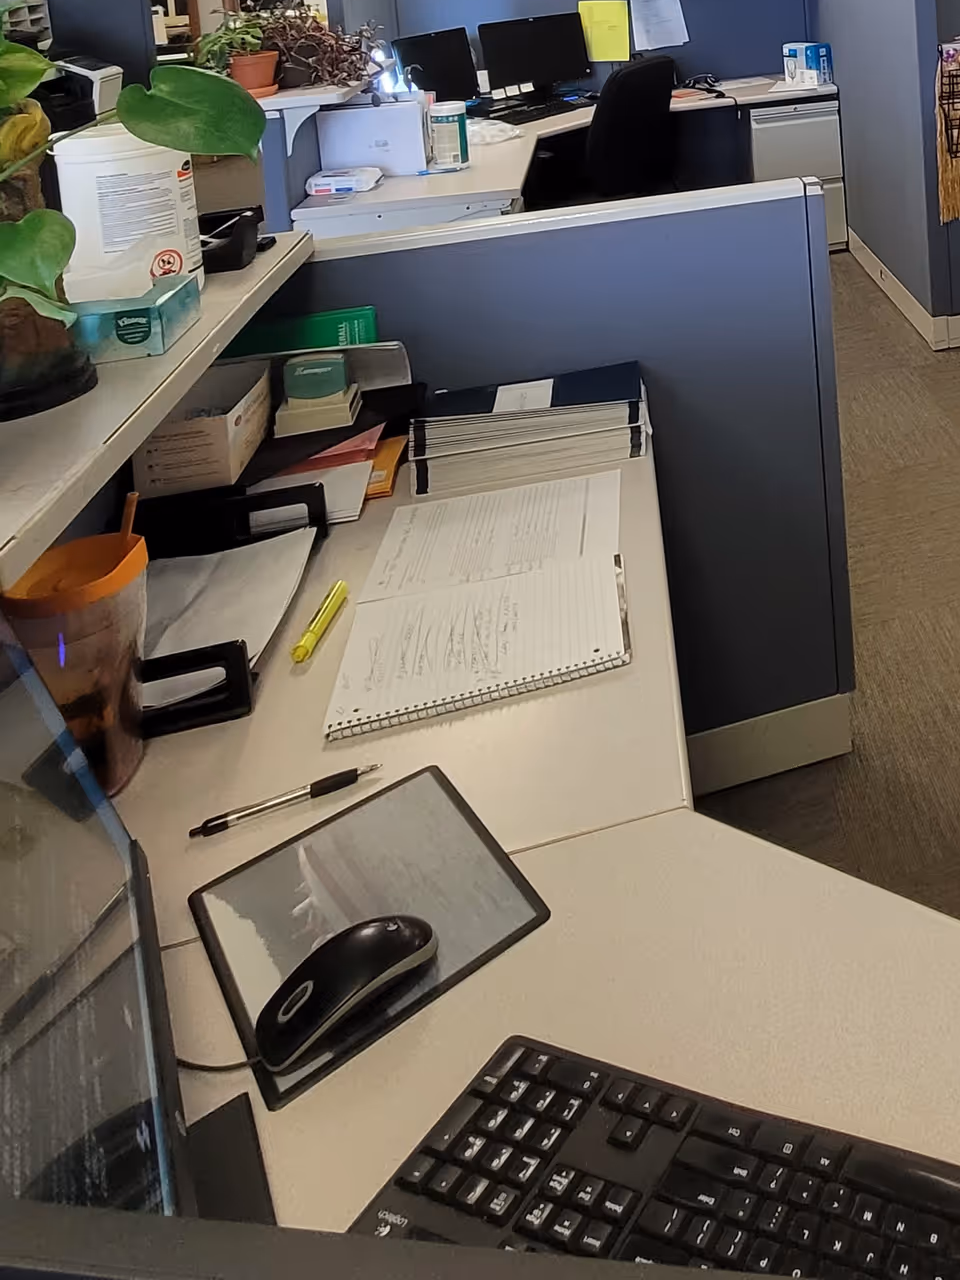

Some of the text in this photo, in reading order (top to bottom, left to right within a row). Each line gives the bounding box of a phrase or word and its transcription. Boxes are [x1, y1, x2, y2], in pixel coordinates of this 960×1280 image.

[863, 1210, 873, 1222] M
[896, 1221, 905, 1232] N
[803, 1229, 809, 1240] L
[930, 1233, 938, 1244] B
[833, 1240, 842, 1252] K
[760, 1257, 769, 1268] P
[866, 1252, 875, 1263] J
[900, 1263, 909, 1276] H
